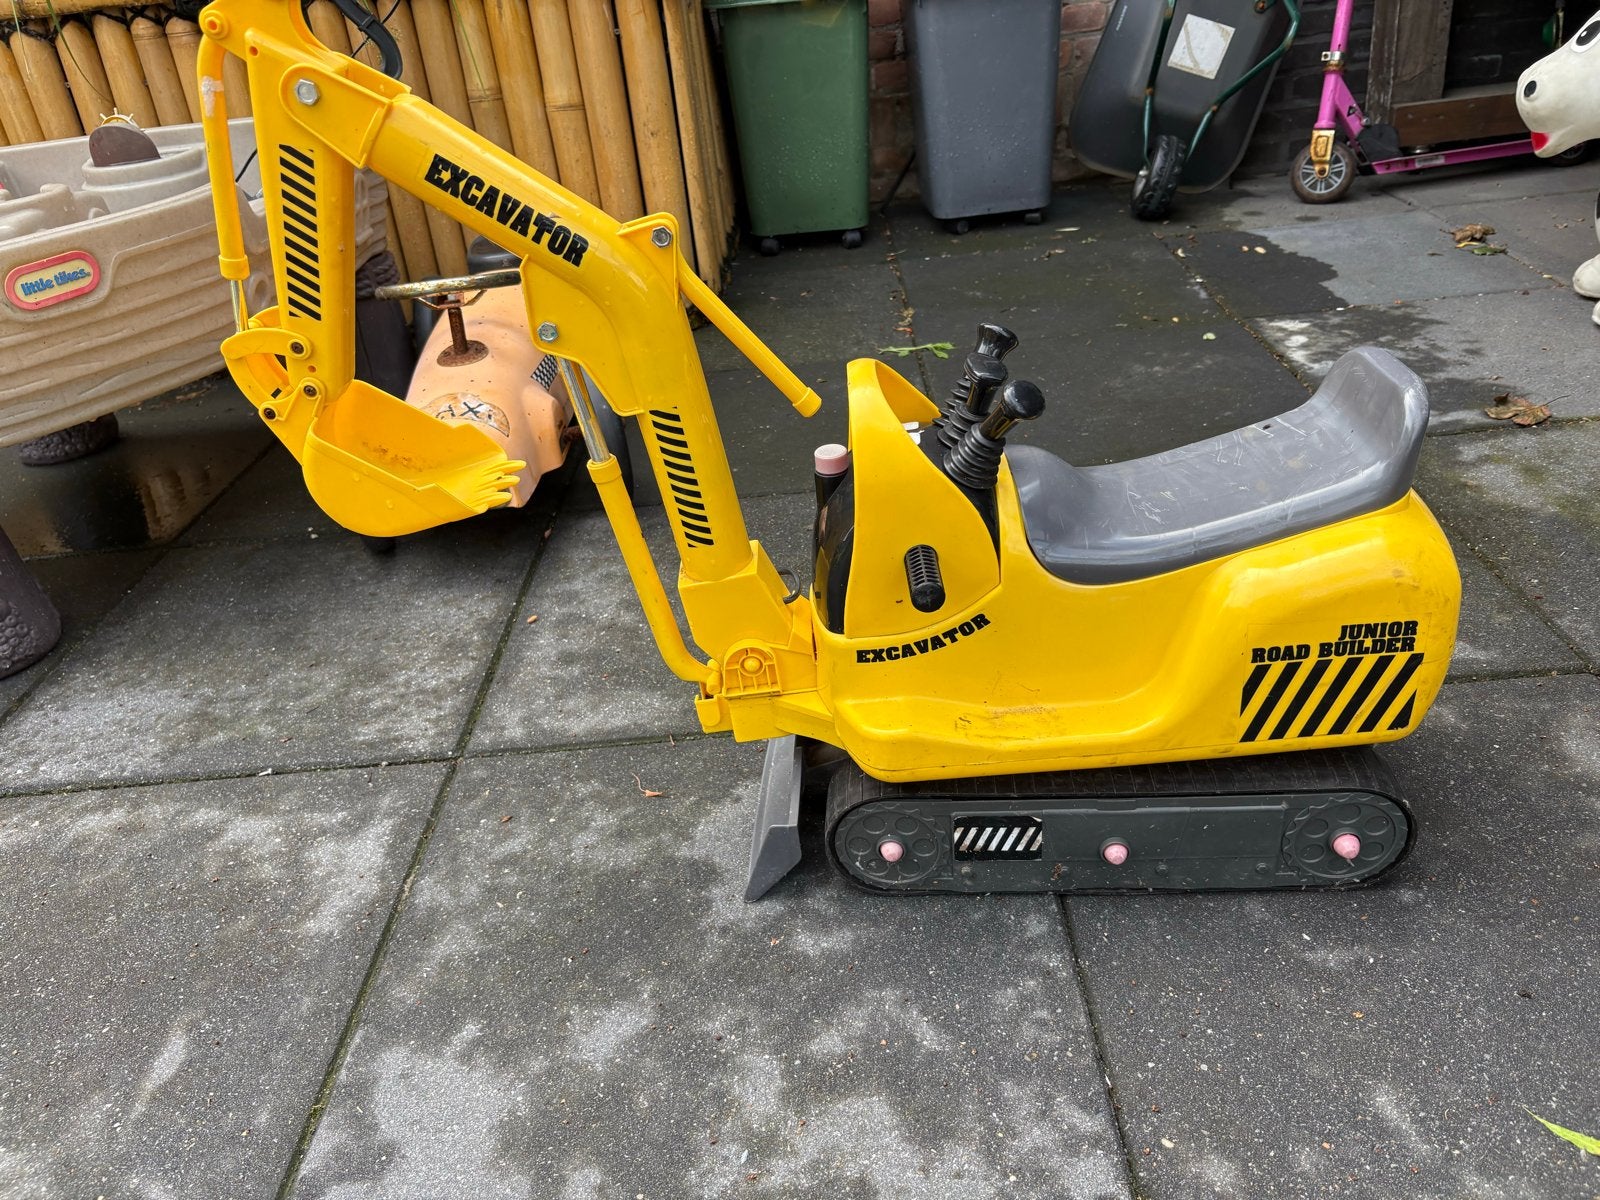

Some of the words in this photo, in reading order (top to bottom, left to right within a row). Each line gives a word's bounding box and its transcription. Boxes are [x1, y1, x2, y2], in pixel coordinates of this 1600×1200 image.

[424, 153, 589, 267] EXCAVATOR
[21, 278, 54, 296] little
[856, 613, 991, 663] EXCAVATOR
[1338, 620, 1418, 641] JUNIOR
[1251, 644, 1311, 663] ROAD
[1318, 637, 1416, 658] BUILDER
